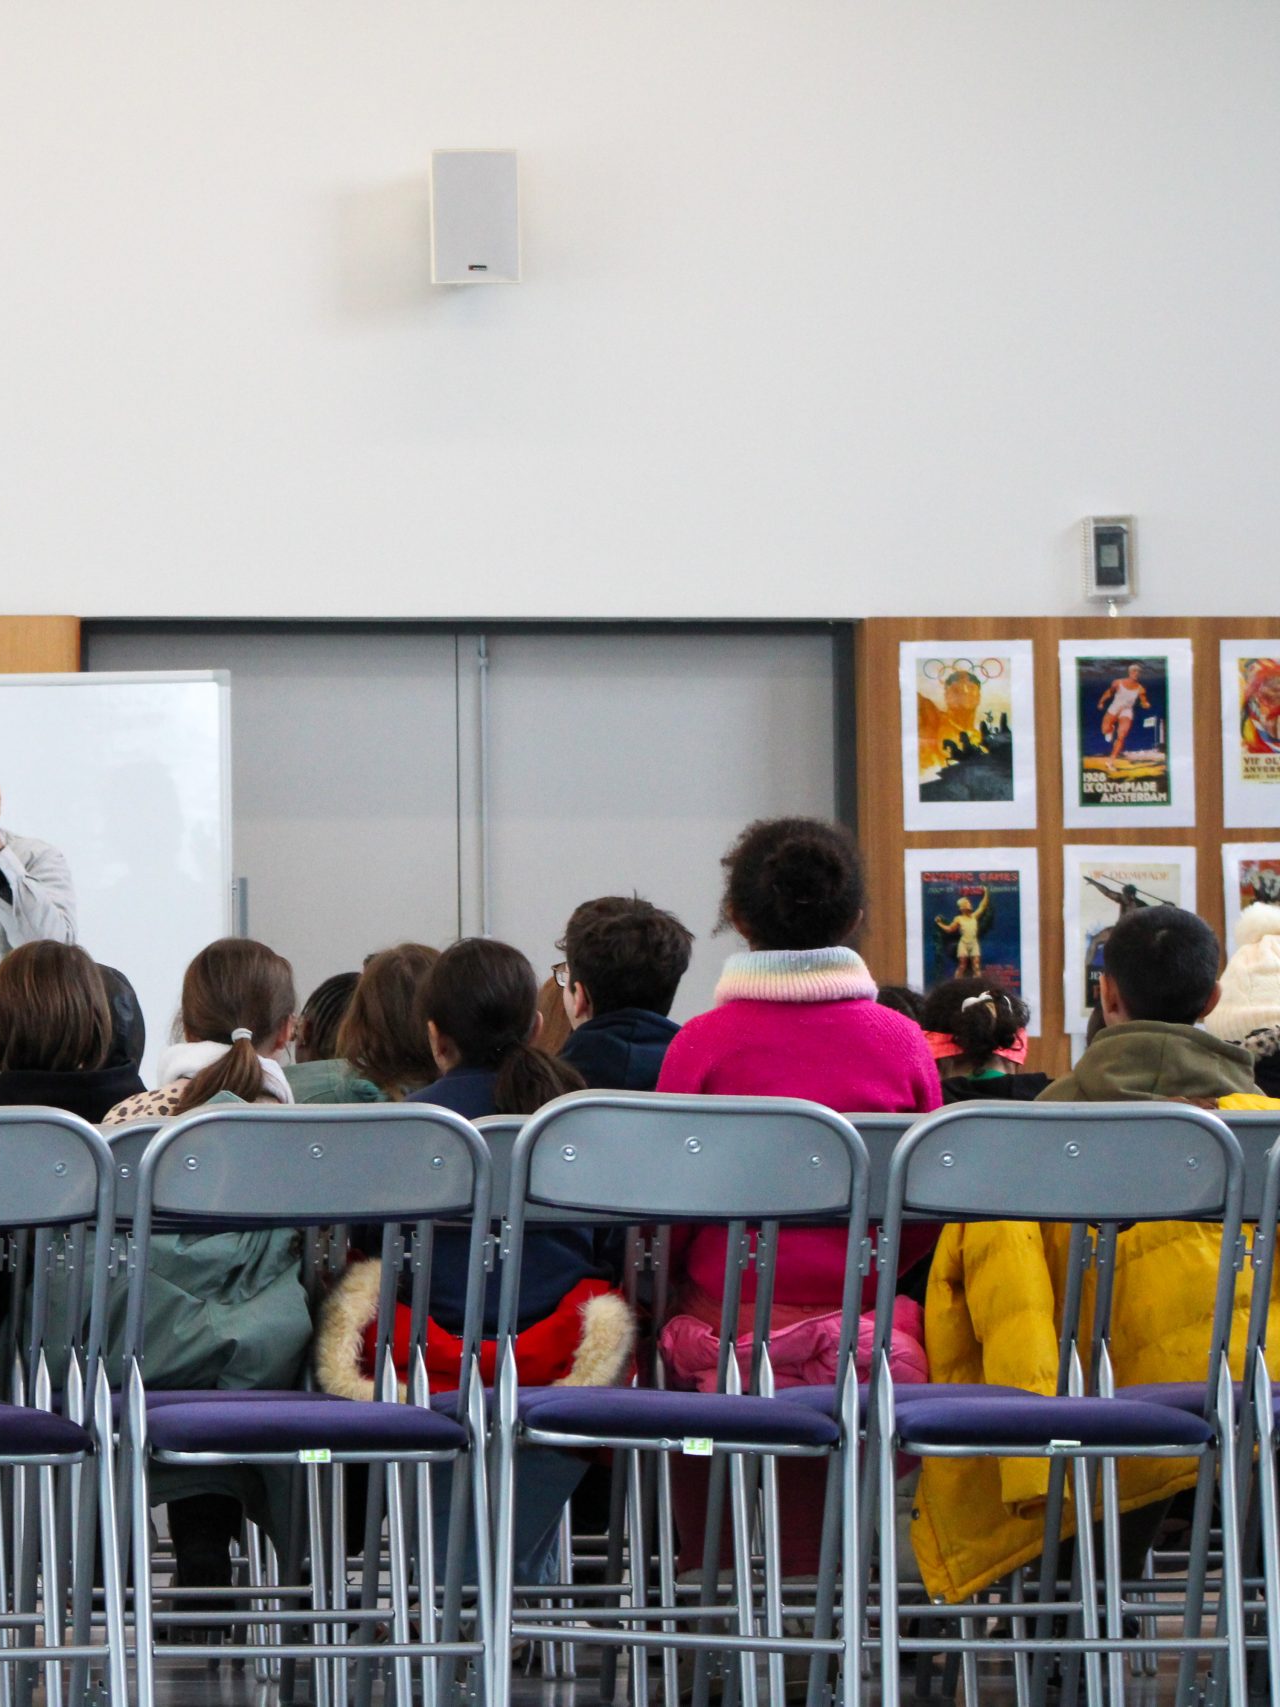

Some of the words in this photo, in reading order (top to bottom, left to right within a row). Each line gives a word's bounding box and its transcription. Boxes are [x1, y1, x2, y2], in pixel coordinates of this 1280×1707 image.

[1082, 772, 1107, 782] 1928
[1095, 781, 1158, 793] OLYMPIADE
[1100, 792, 1168, 803] AMSTERDAM
